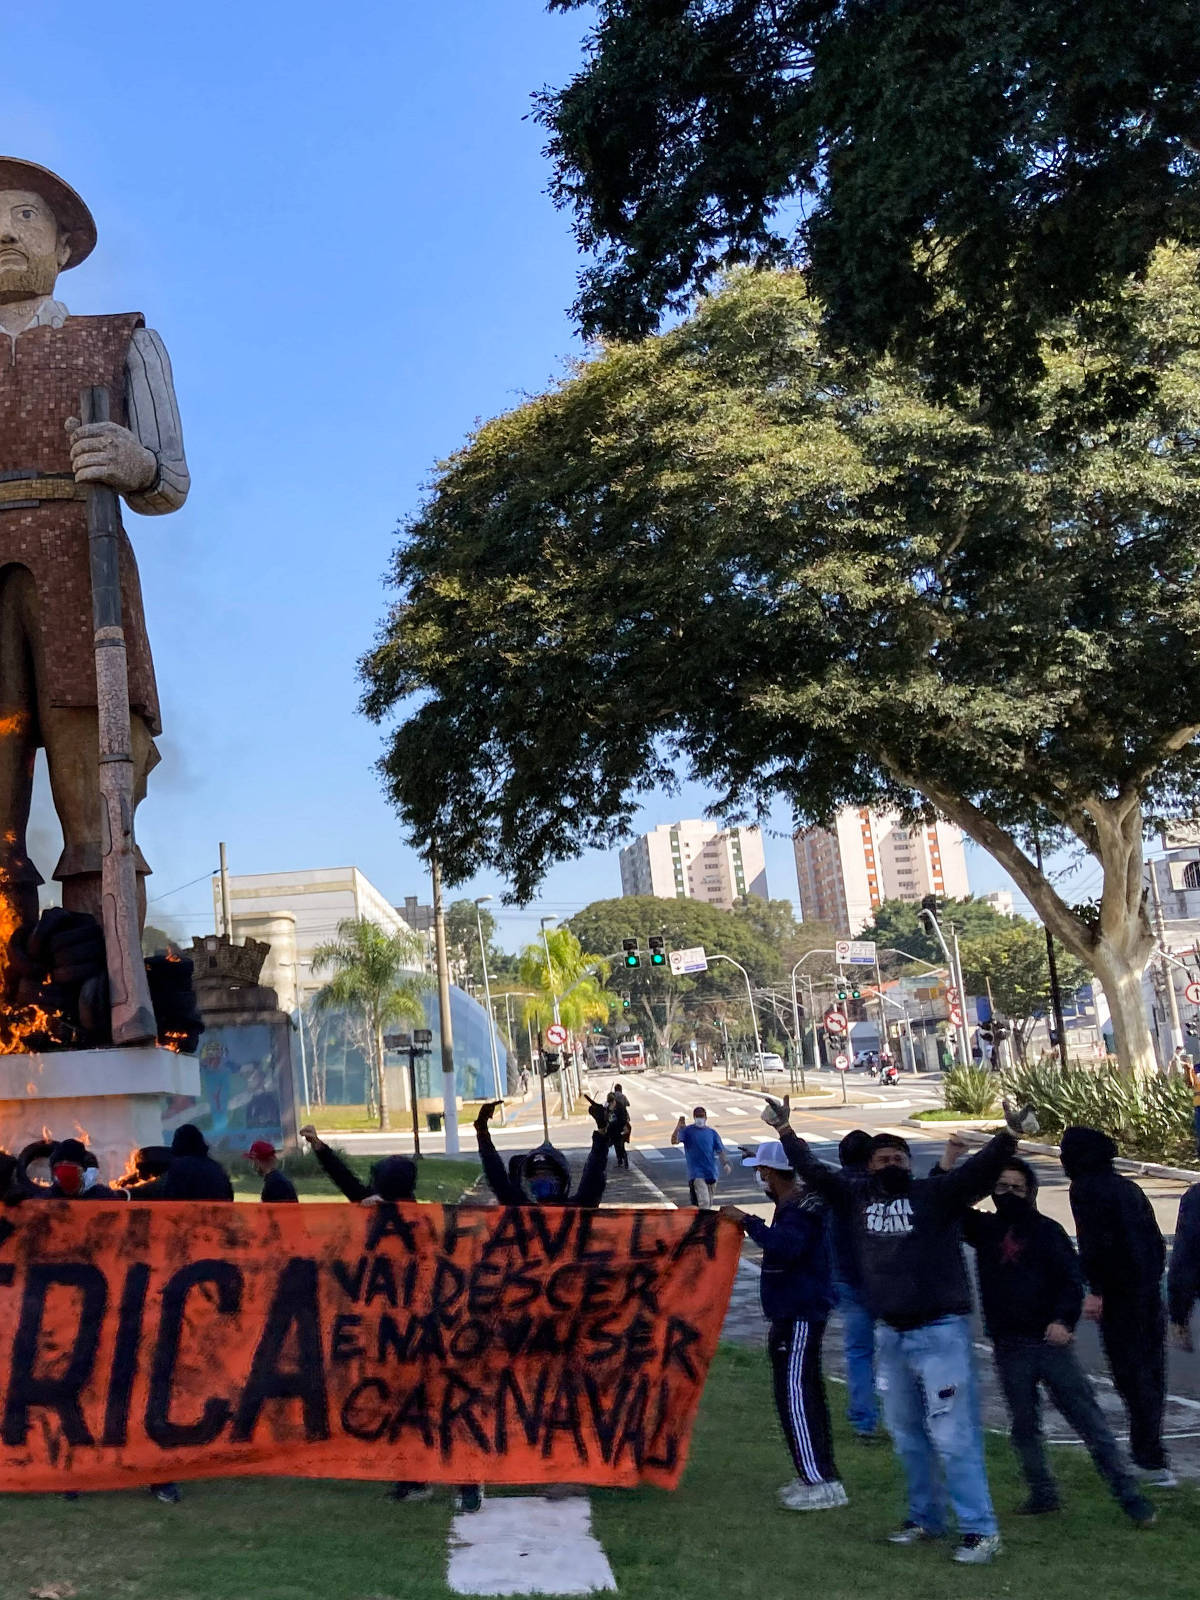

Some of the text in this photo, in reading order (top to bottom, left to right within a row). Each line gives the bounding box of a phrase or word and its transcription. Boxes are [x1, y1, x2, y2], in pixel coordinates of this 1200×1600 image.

[366, 1202, 722, 1263] A FAVELA
[331, 1254, 661, 1315] VAI DESCER
[331, 1313, 364, 1362] E
[586, 1309, 703, 1384] SER
[340, 1366, 684, 1474] CARNAVAL
